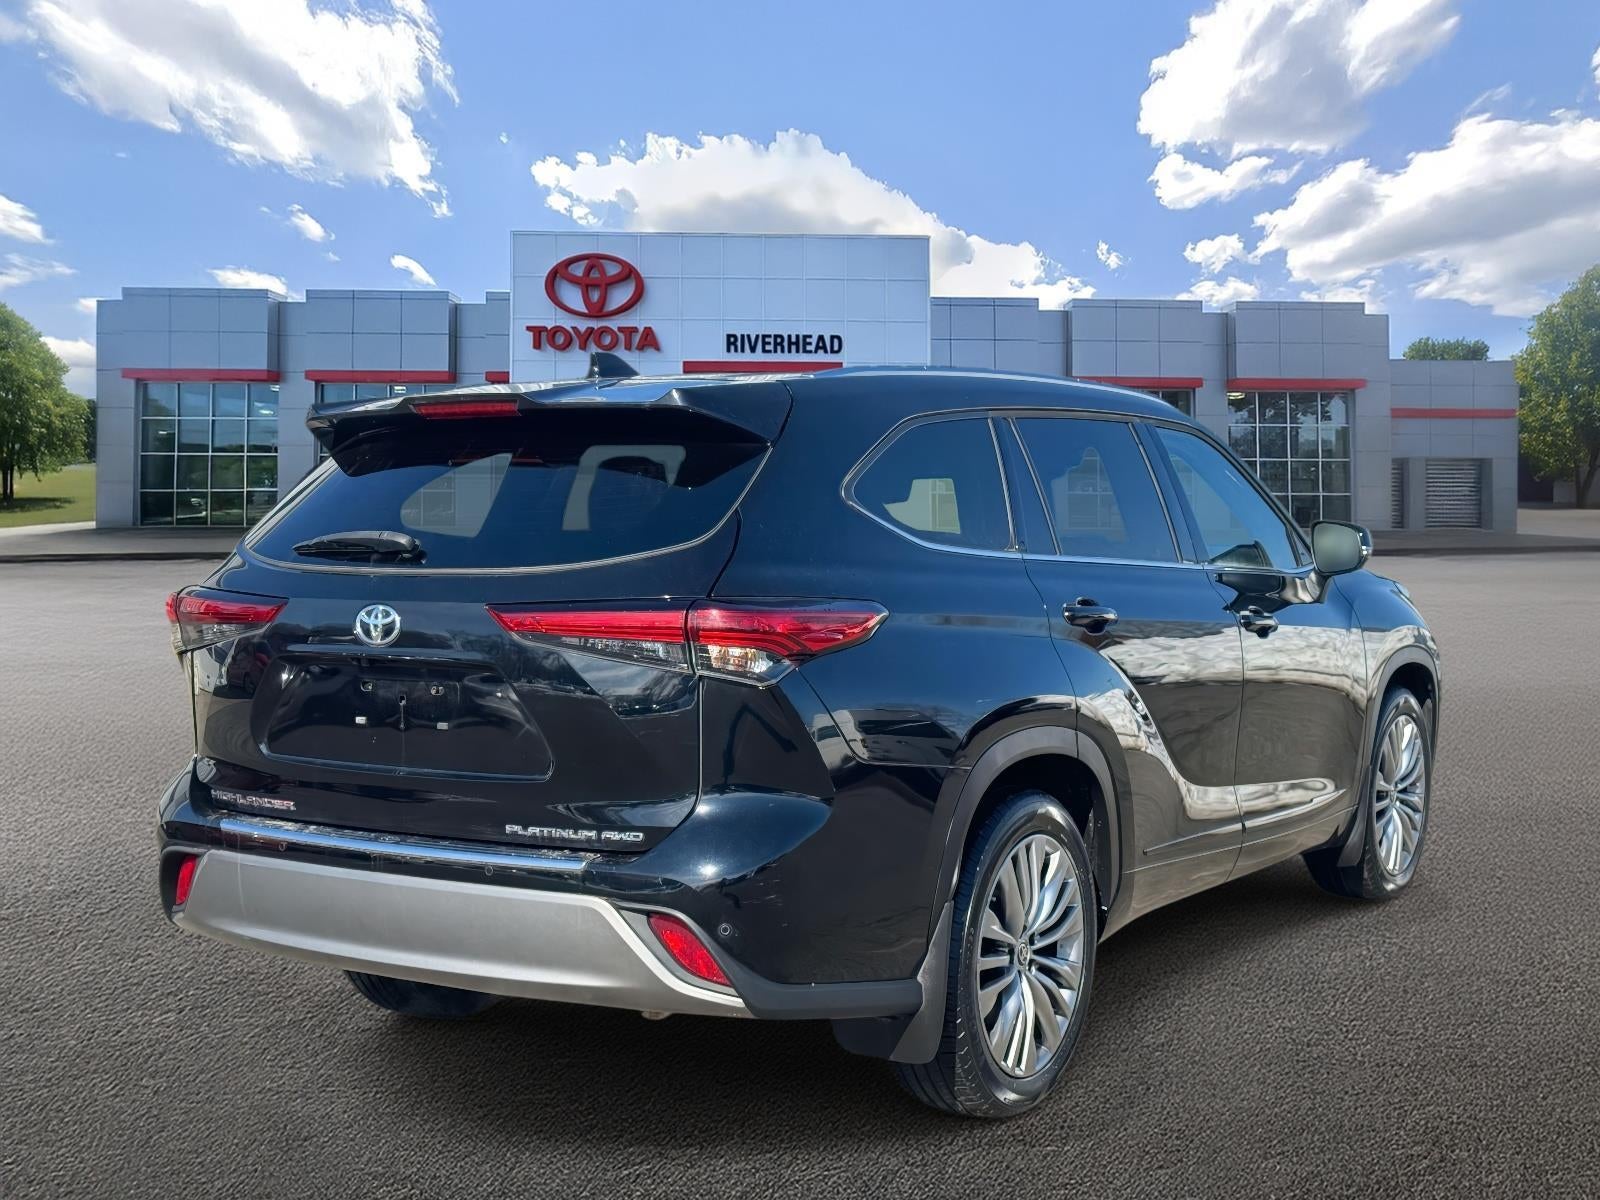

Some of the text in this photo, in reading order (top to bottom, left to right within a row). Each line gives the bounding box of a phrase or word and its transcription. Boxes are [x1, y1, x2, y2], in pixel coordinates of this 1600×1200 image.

[526, 325, 661, 352] TOYOTA
[725, 333, 843, 355] RIVERHEAD
[210, 789, 296, 811] HIGHLANDER
[505, 824, 644, 842] PLATINUM AWD
